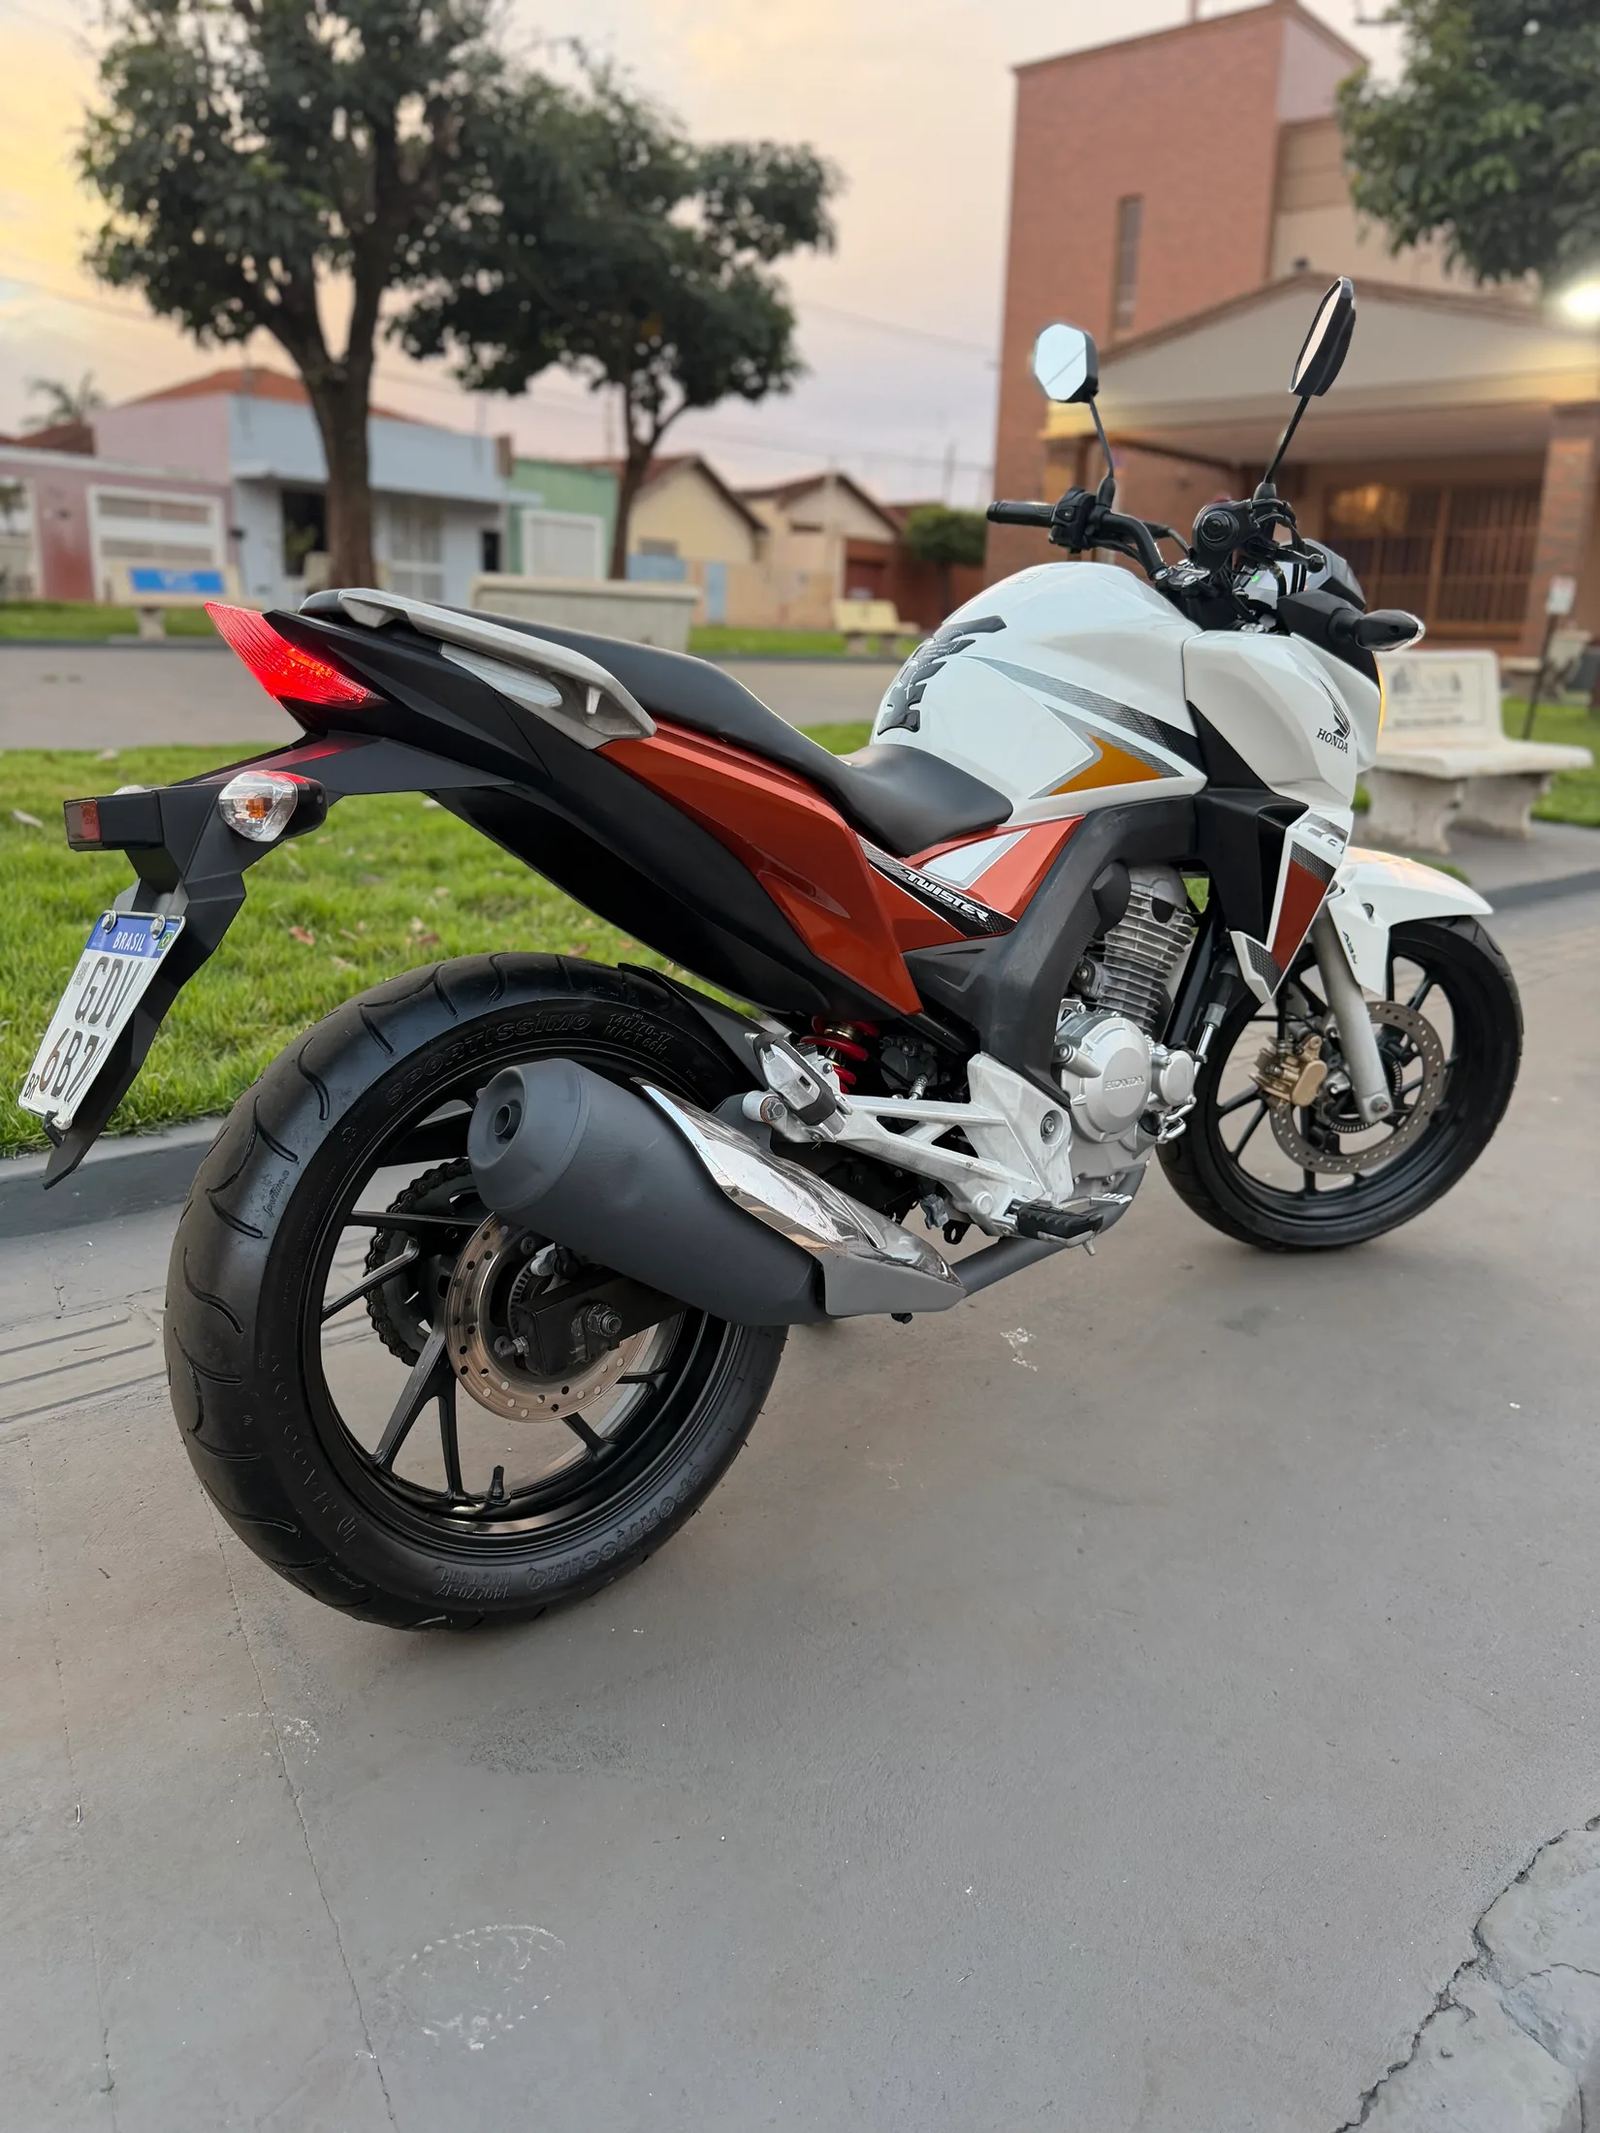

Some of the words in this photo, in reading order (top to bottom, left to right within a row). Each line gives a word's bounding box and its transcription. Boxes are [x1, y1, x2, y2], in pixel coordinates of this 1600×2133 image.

[1316, 727, 1348, 754] HONDA
[904, 869, 989, 922] TWISTER
[112, 931, 146, 952] BRASIL
[74, 955, 143, 1029] GDV
[24, 1073, 41, 1100] BR
[1104, 1076, 1144, 1090] HONDA
